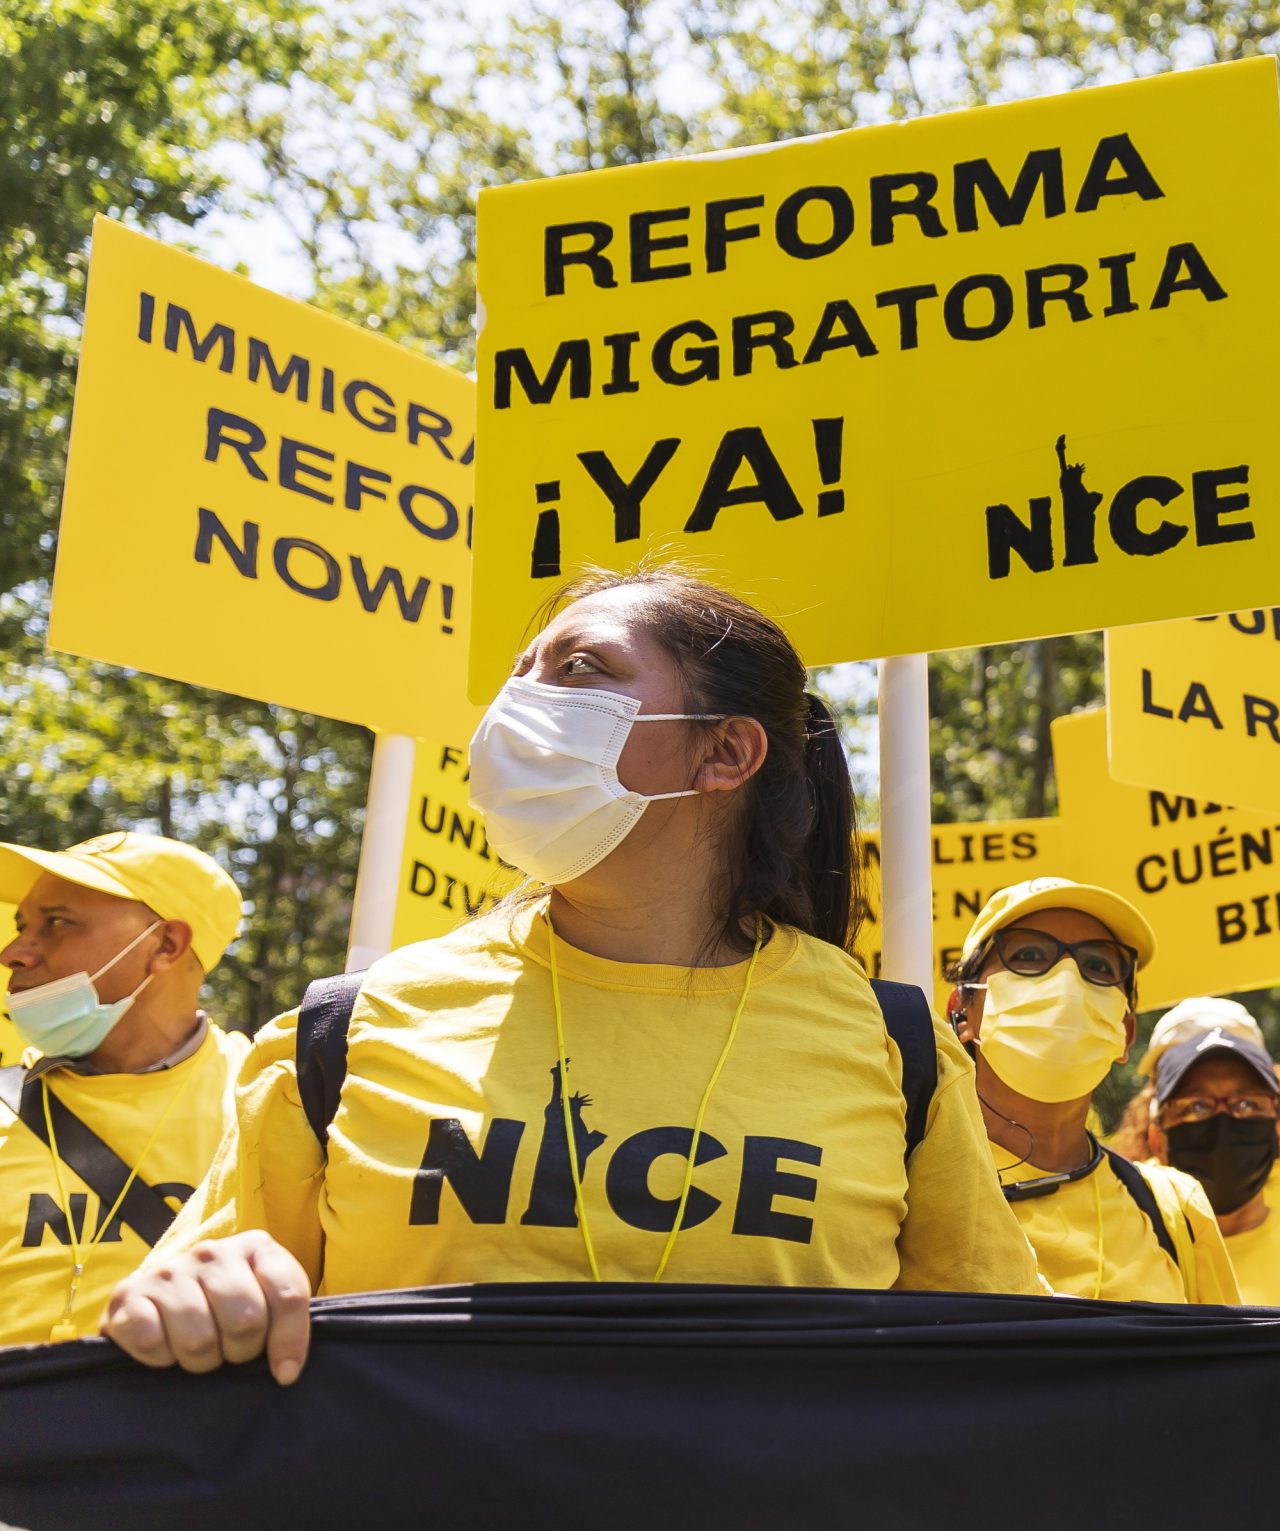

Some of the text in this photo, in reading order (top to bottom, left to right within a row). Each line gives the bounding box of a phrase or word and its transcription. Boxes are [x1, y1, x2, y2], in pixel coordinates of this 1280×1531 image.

[544, 132, 1165, 296] REFORMA
[137, 292, 474, 466] IMMIGR
[494, 242, 1228, 410] MIGRATORIA
[203, 407, 471, 550] REFO
[529, 415, 845, 579] ¡YA!
[986, 433, 1255, 580] NICE
[195, 507, 456, 636] NOW!
[1142, 669, 1224, 730] LA
[409, 1057, 823, 1244] NICE
